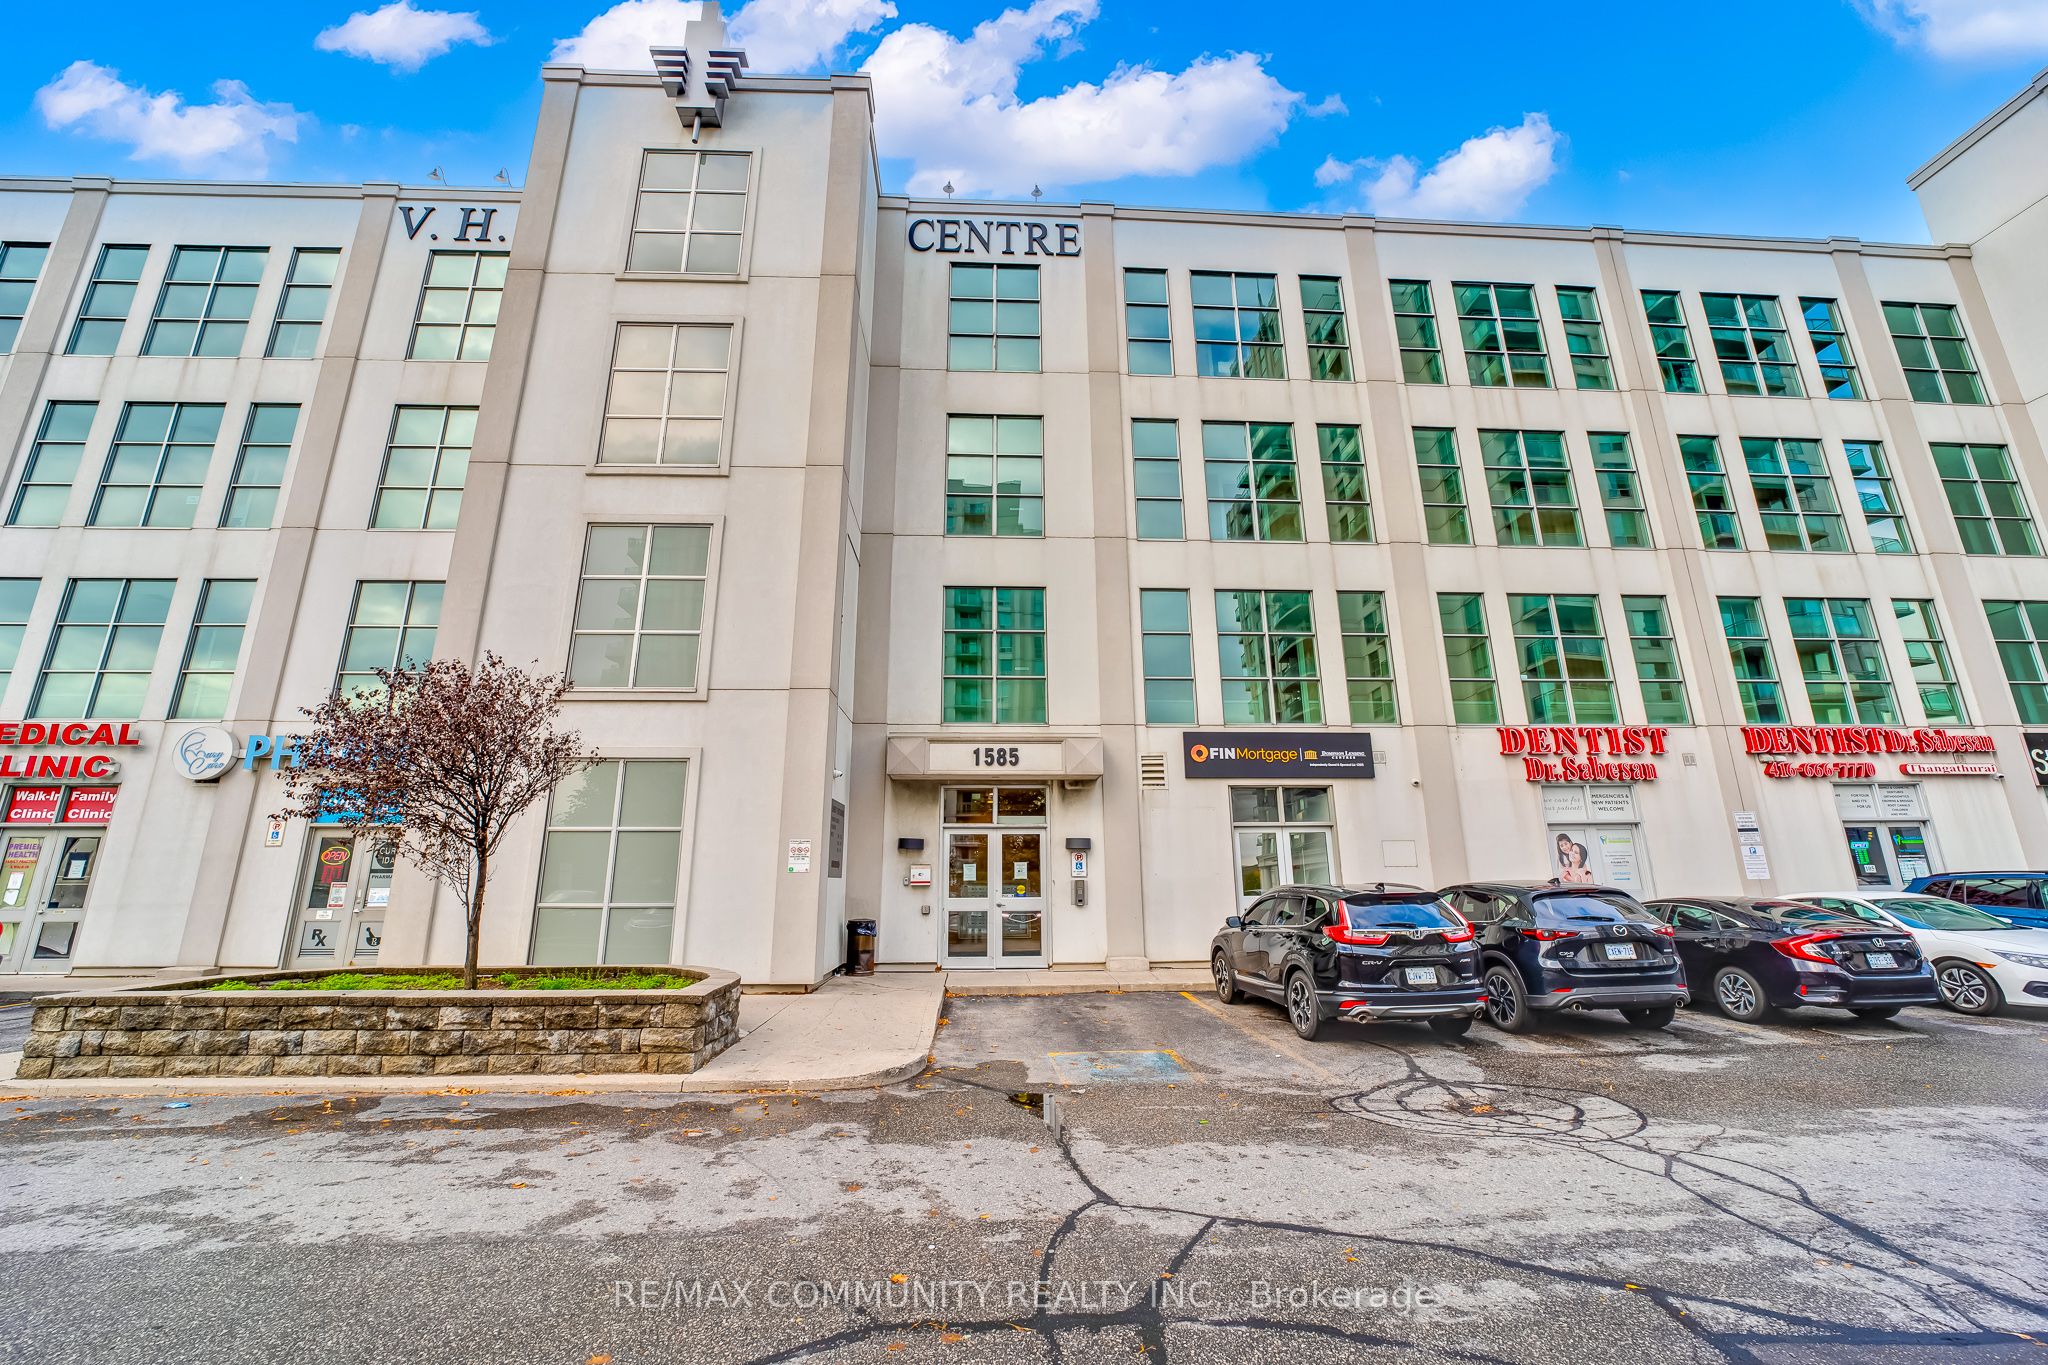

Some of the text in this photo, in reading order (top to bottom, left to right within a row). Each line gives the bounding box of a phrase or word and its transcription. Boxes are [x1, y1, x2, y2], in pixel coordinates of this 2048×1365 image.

[398, 206, 506, 243] V. H.
[908, 218, 1082, 257] CENTRE
[0, 723, 141, 746] EDICAL
[1497, 727, 1668, 755] DENTIST
[1740, 727, 1887, 754] DENTIST
[0, 755, 113, 779] LINIC
[973, 747, 1020, 767] 1585
[1909, 764, 1996, 774] Thangathurai
[71, 791, 117, 804] Family
[10, 808, 112, 819] Clinic Clinic
[322, 851, 348, 861] OPEN
